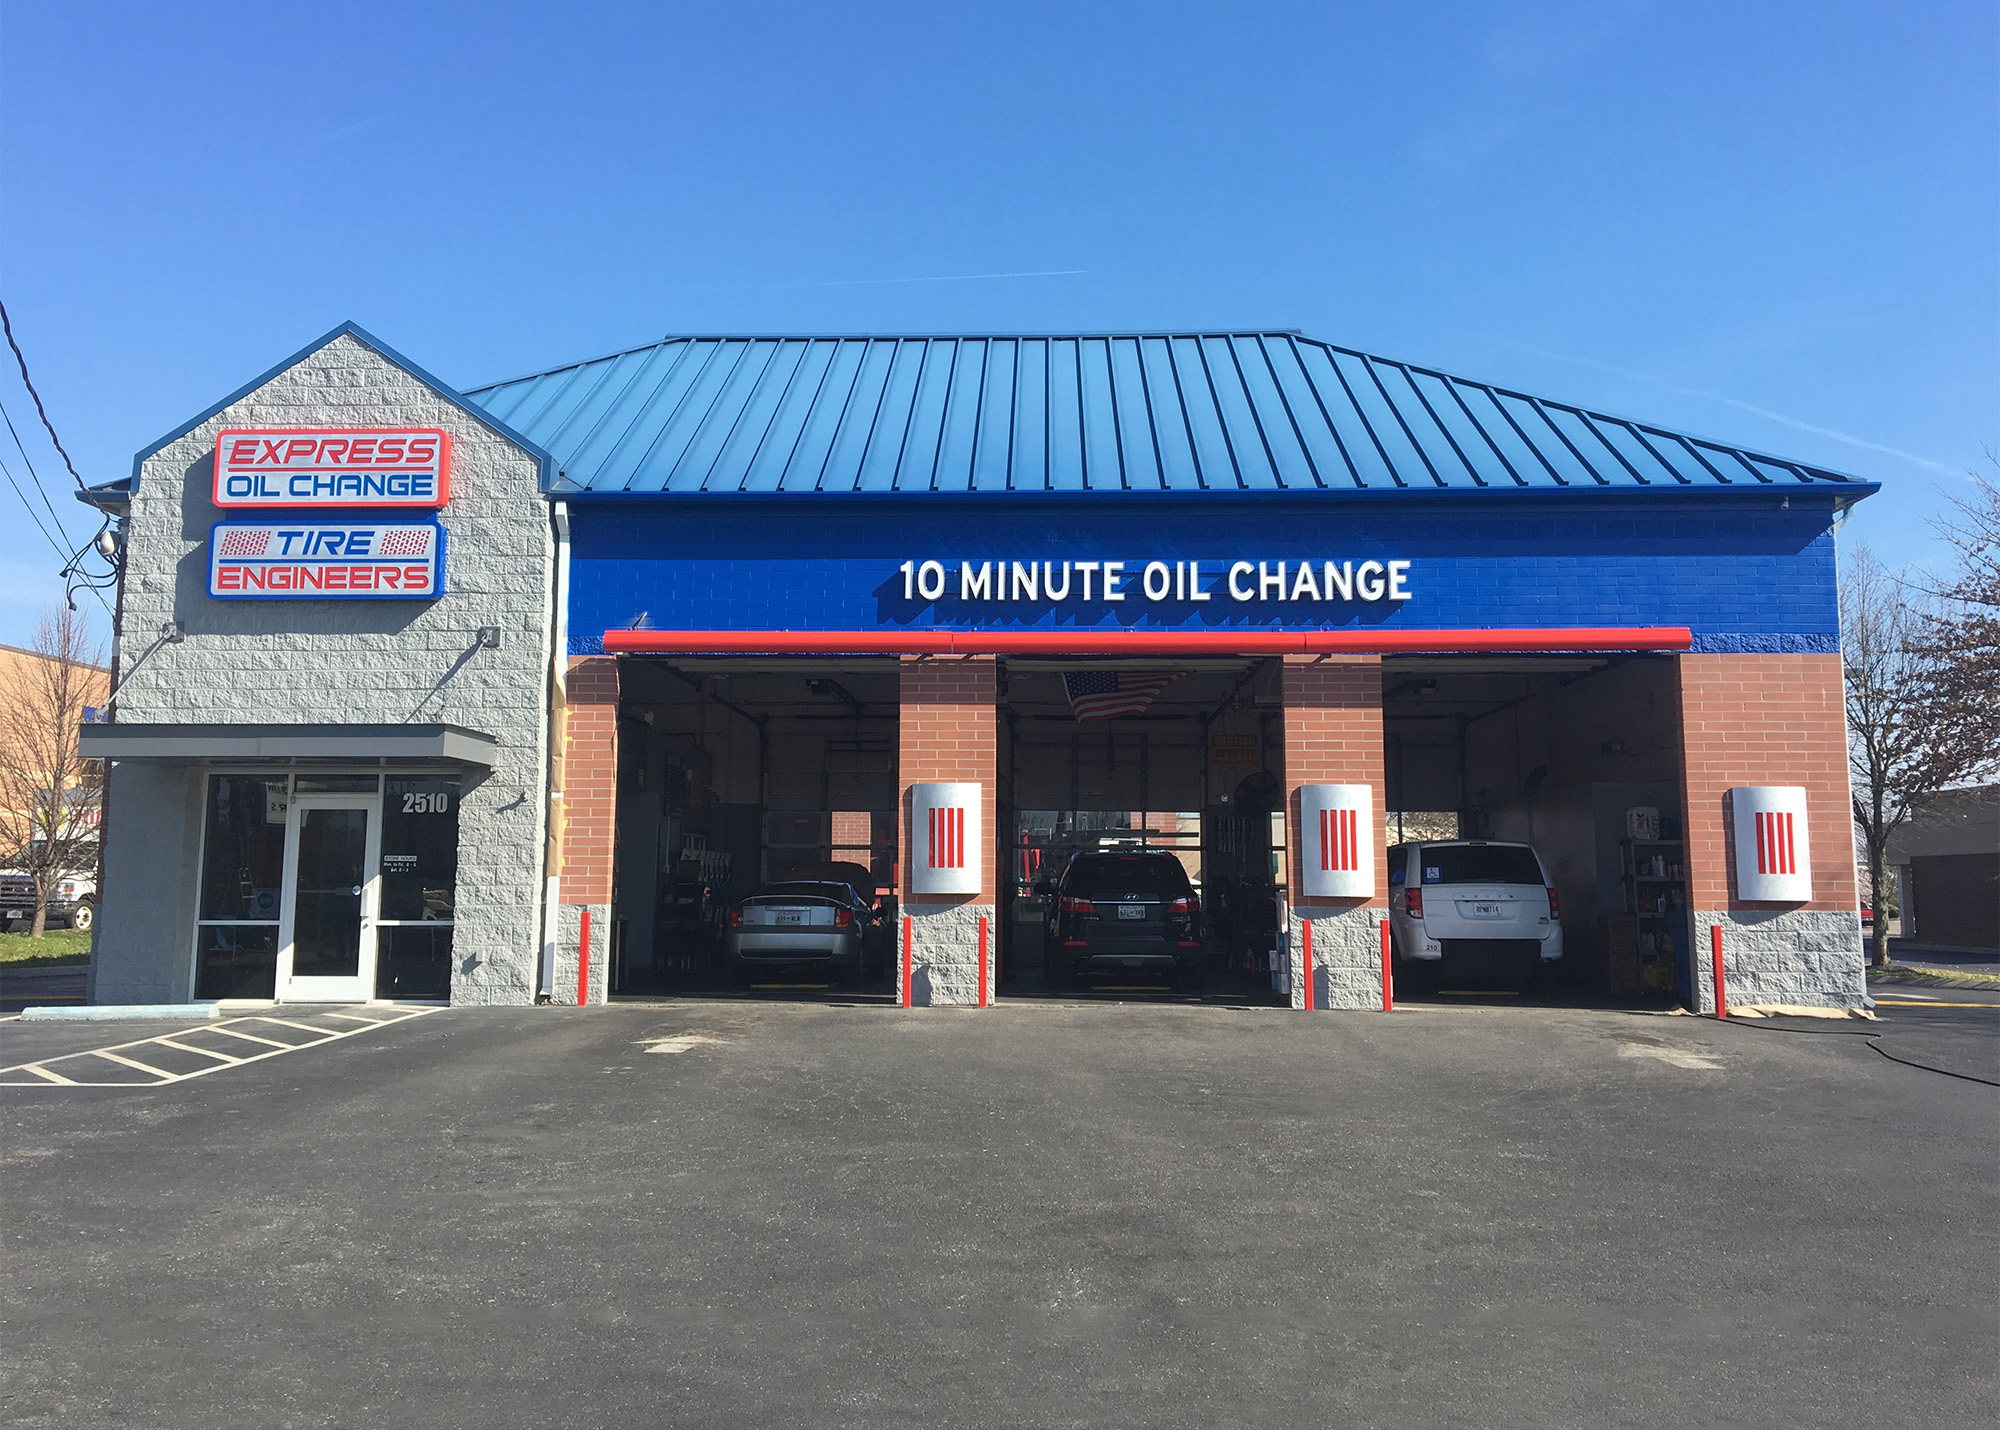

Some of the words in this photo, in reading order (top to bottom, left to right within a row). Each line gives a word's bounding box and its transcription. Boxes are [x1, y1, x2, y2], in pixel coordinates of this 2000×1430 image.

[228, 438, 437, 465] EXPRESS
[226, 475, 280, 497] OIL
[288, 474, 433, 497] CHANGE
[276, 530, 376, 556] TIRE
[217, 566, 429, 590] ENGINEERS
[900, 560, 946, 601] 10
[961, 560, 1126, 601] MINUTE
[1143, 560, 1211, 601] OIL
[1228, 560, 1413, 601] CHANGE
[402, 792, 449, 813] 2510
